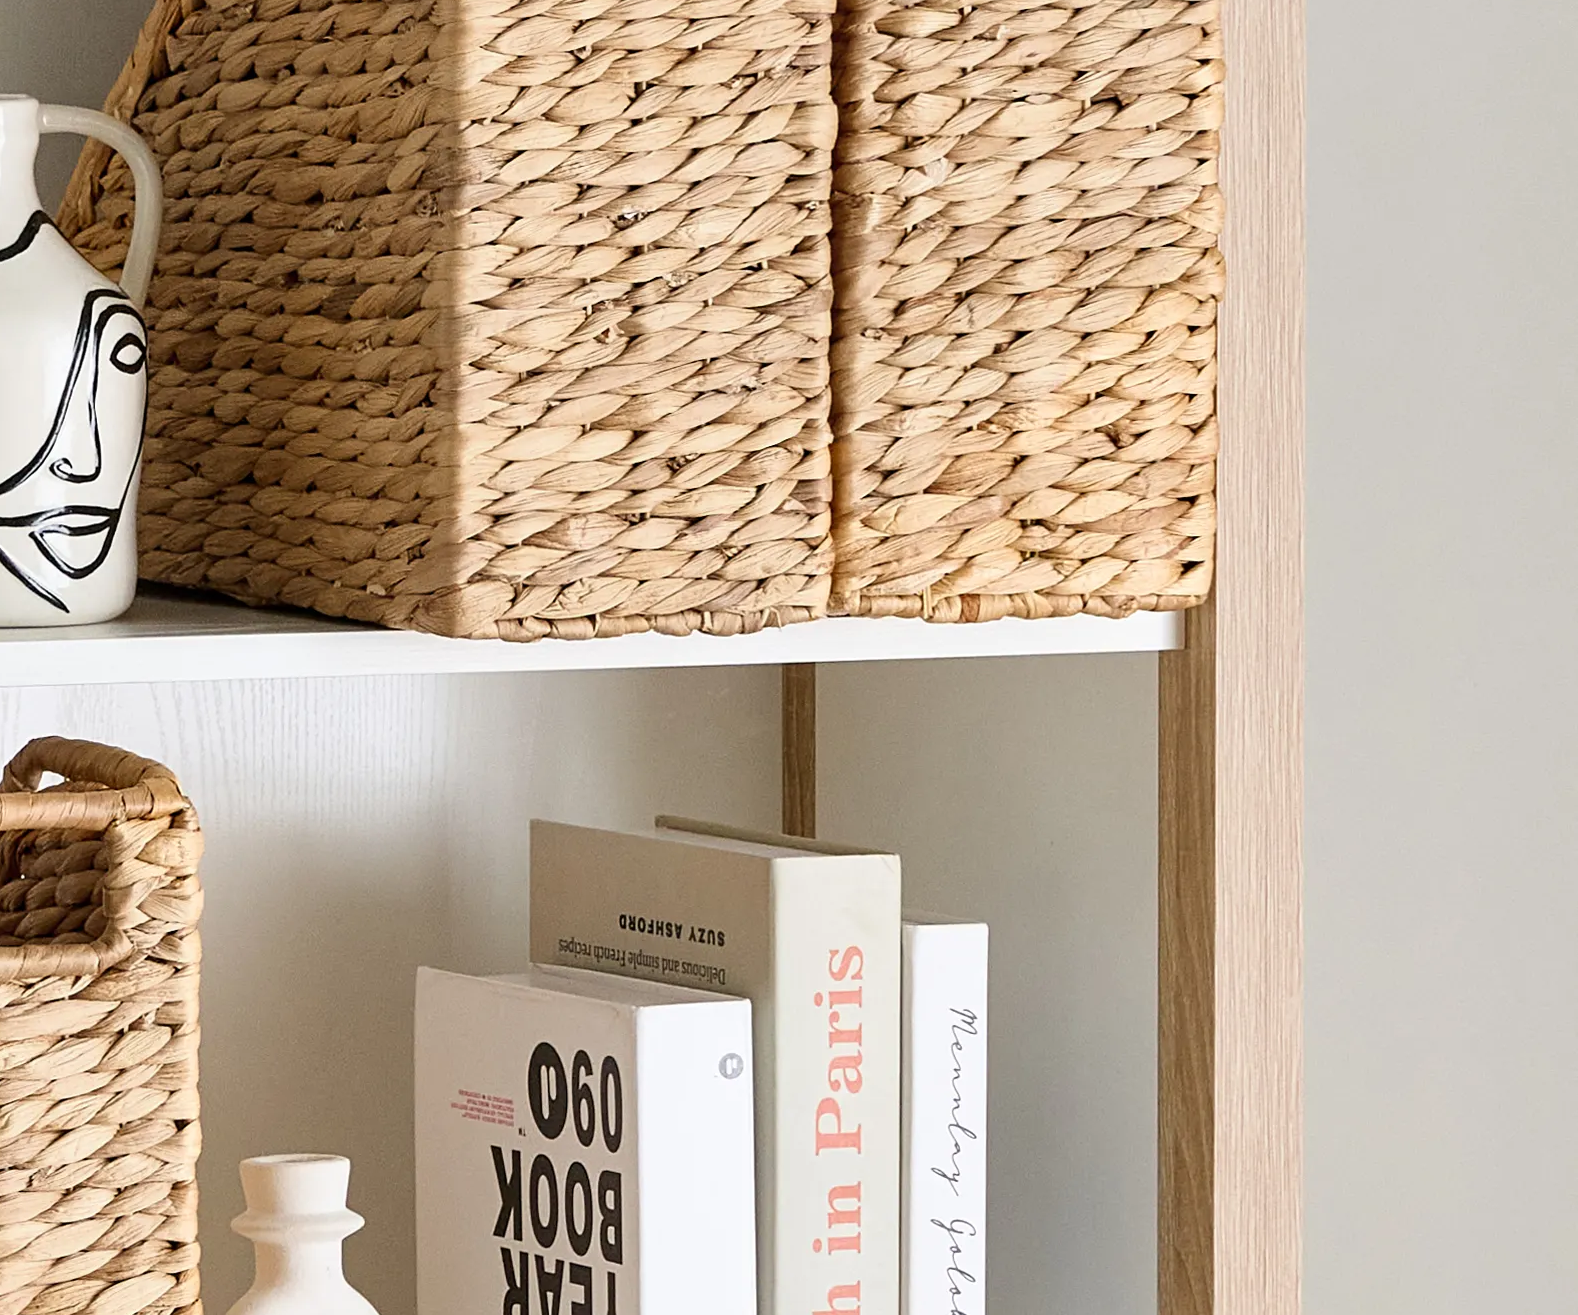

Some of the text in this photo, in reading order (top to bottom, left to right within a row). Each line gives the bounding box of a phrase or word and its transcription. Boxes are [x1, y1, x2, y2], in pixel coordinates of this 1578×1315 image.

[558, 937, 726, 985] Delicious and simple French recipes
[619, 914, 725, 947] SUZY ASHFORD
[813, 944, 864, 1155] Paris
[490, 1145, 623, 1265] BOOK
[812, 1181, 863, 1254] in
